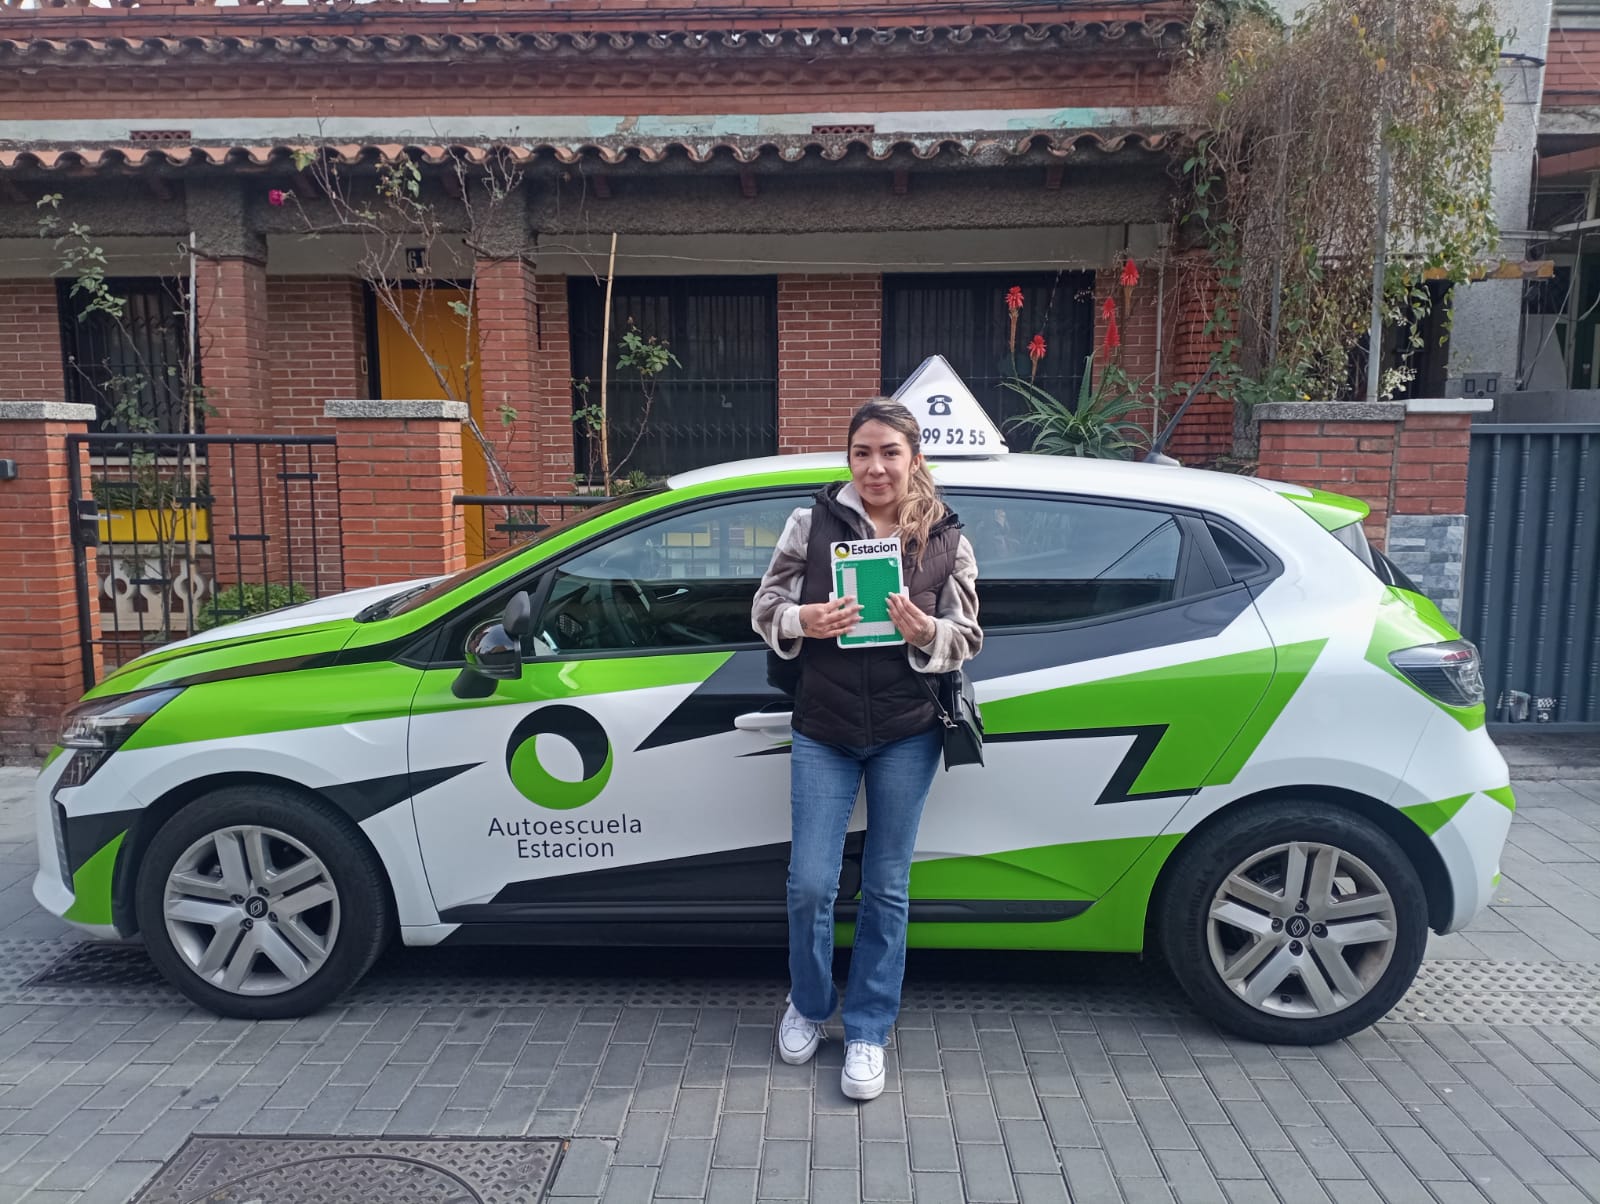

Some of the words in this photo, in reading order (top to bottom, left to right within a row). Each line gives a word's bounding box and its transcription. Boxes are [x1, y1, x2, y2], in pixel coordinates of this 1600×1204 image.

[919, 428, 941, 444] 99
[946, 428, 964, 445] 52
[969, 429, 986, 445] 55
[851, 542, 898, 555] Estacion
[488, 813, 642, 837] Autoescuela
[517, 837, 614, 859] Estacion
